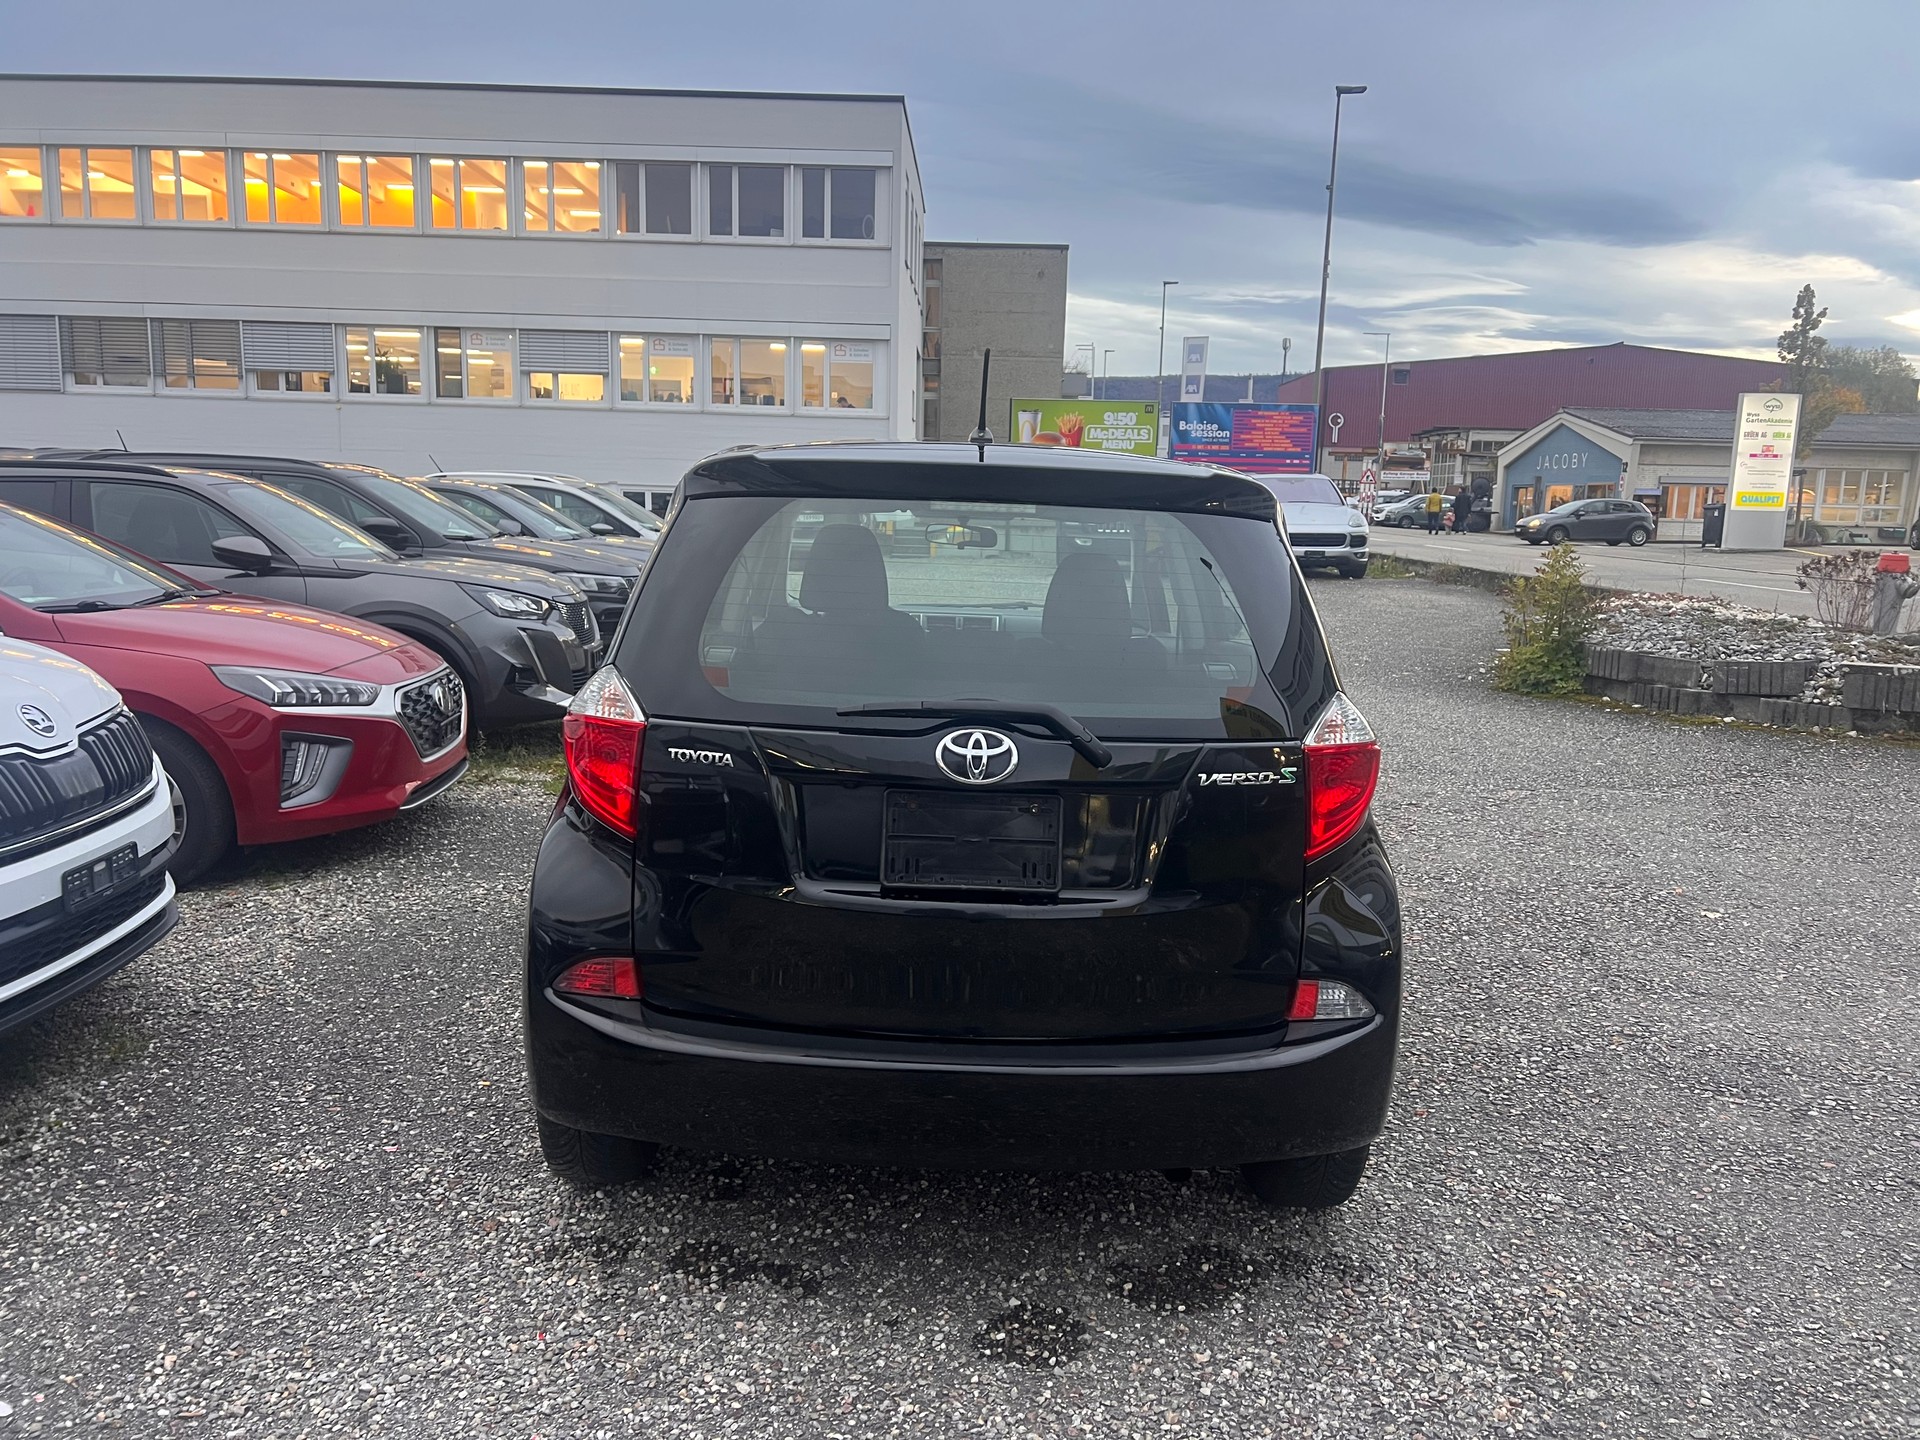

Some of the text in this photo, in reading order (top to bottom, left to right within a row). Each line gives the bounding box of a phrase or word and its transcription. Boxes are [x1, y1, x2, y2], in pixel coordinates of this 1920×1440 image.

[1179, 420, 1219, 431] Baloise
[1089, 428, 1149, 440] McDEALS
[1190, 430, 1230, 438] session
[1102, 440, 1135, 449] MENU
[1536, 452, 1588, 470] JACOBY
[1741, 495, 1780, 504] QUALIPET
[668, 747, 734, 767] TOYOTA
[1197, 767, 1297, 786] VERSO-S
